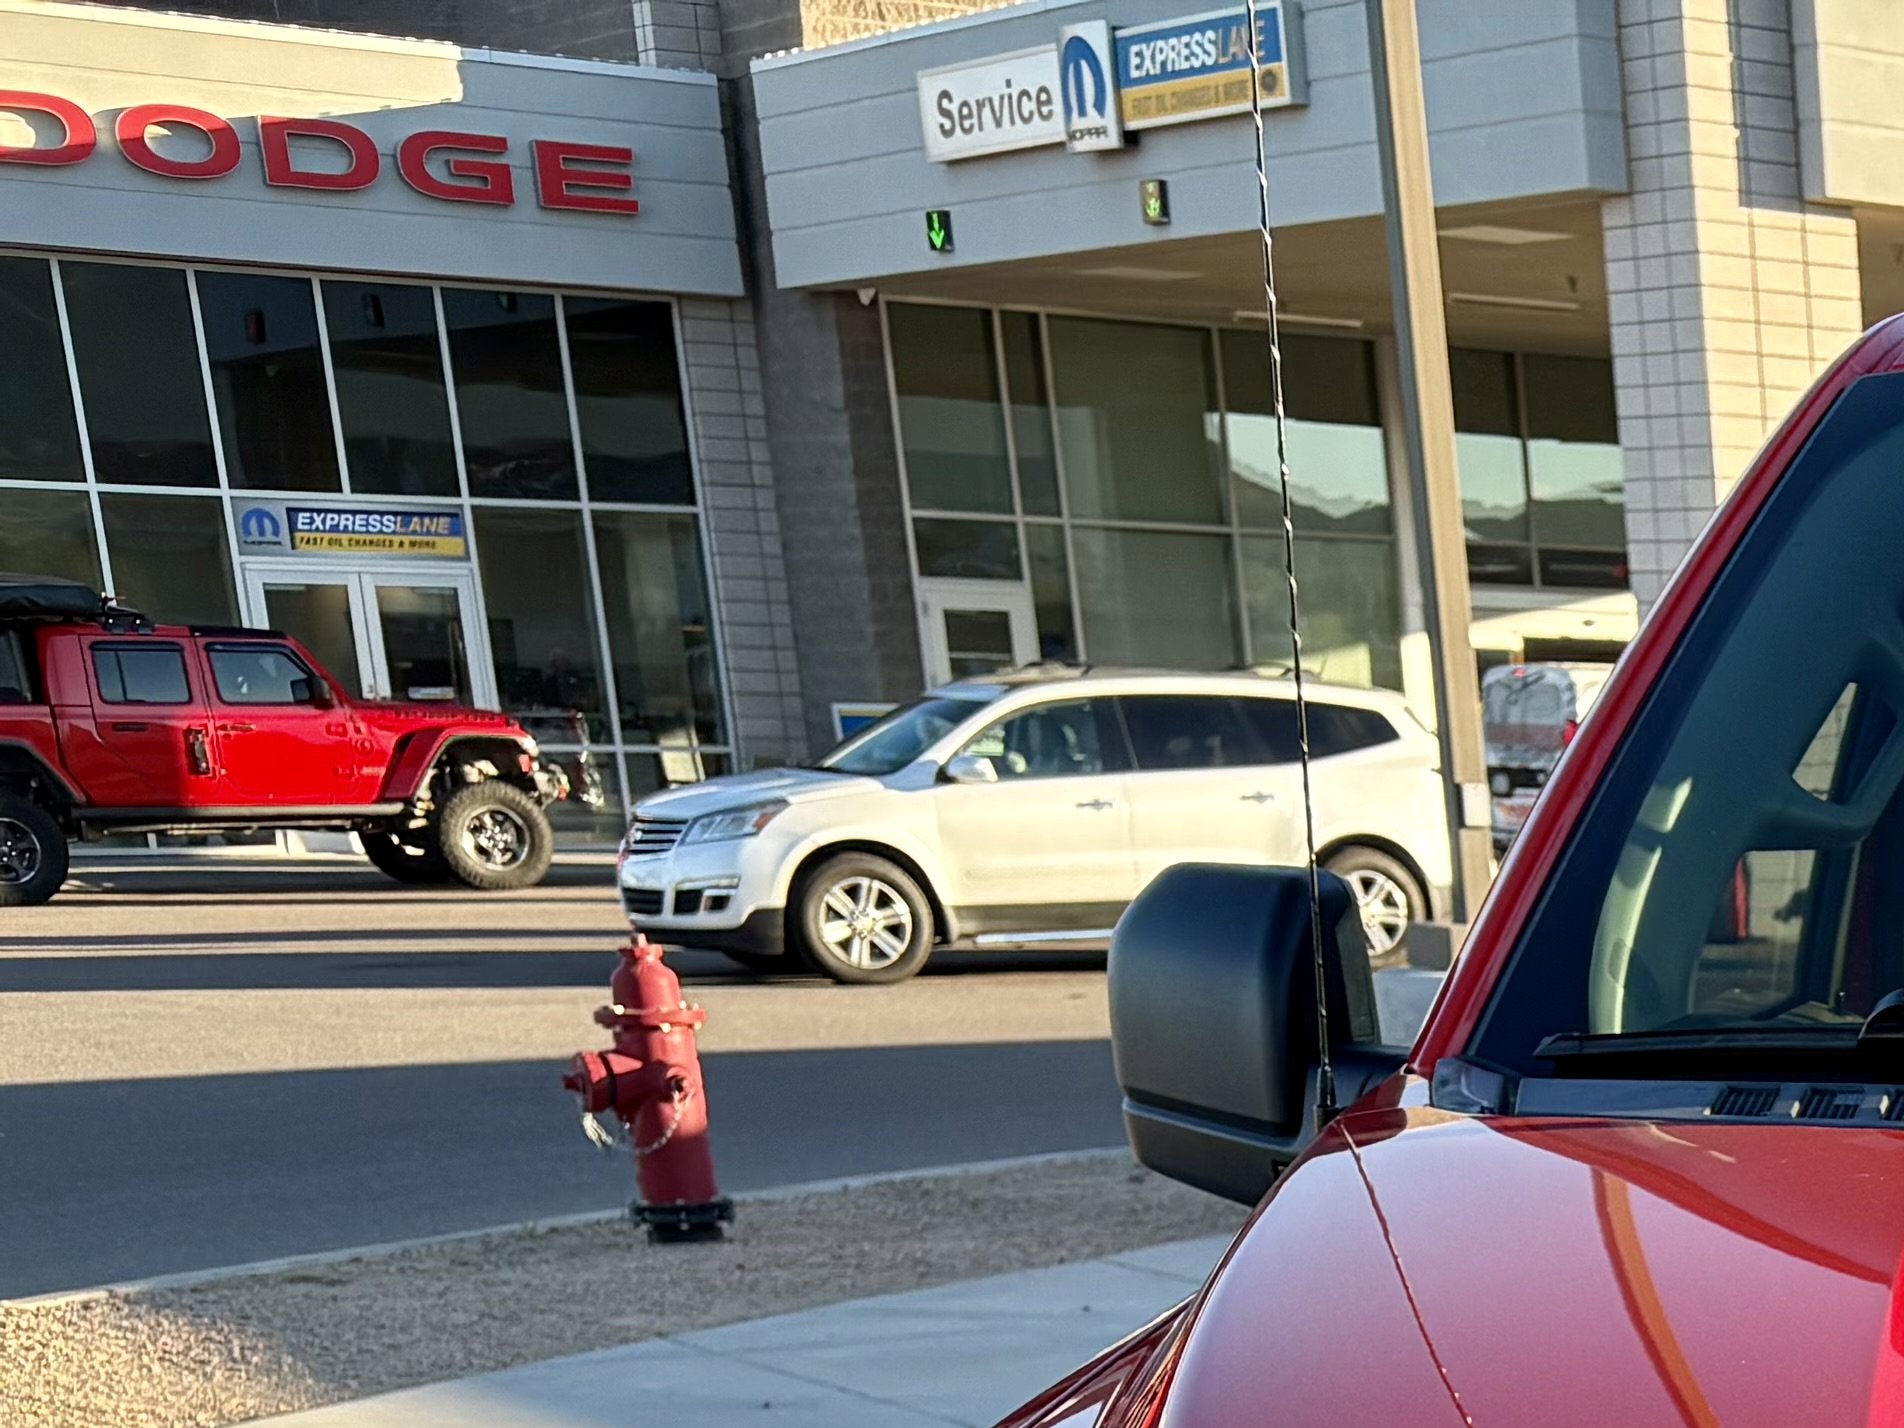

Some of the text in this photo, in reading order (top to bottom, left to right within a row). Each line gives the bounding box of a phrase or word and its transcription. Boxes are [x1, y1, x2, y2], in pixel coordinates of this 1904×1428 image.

[936, 78, 1054, 139] Service
[0, 89, 640, 215] DODGE
[299, 536, 324, 546] FAST
[327, 537, 343, 547] OIL
